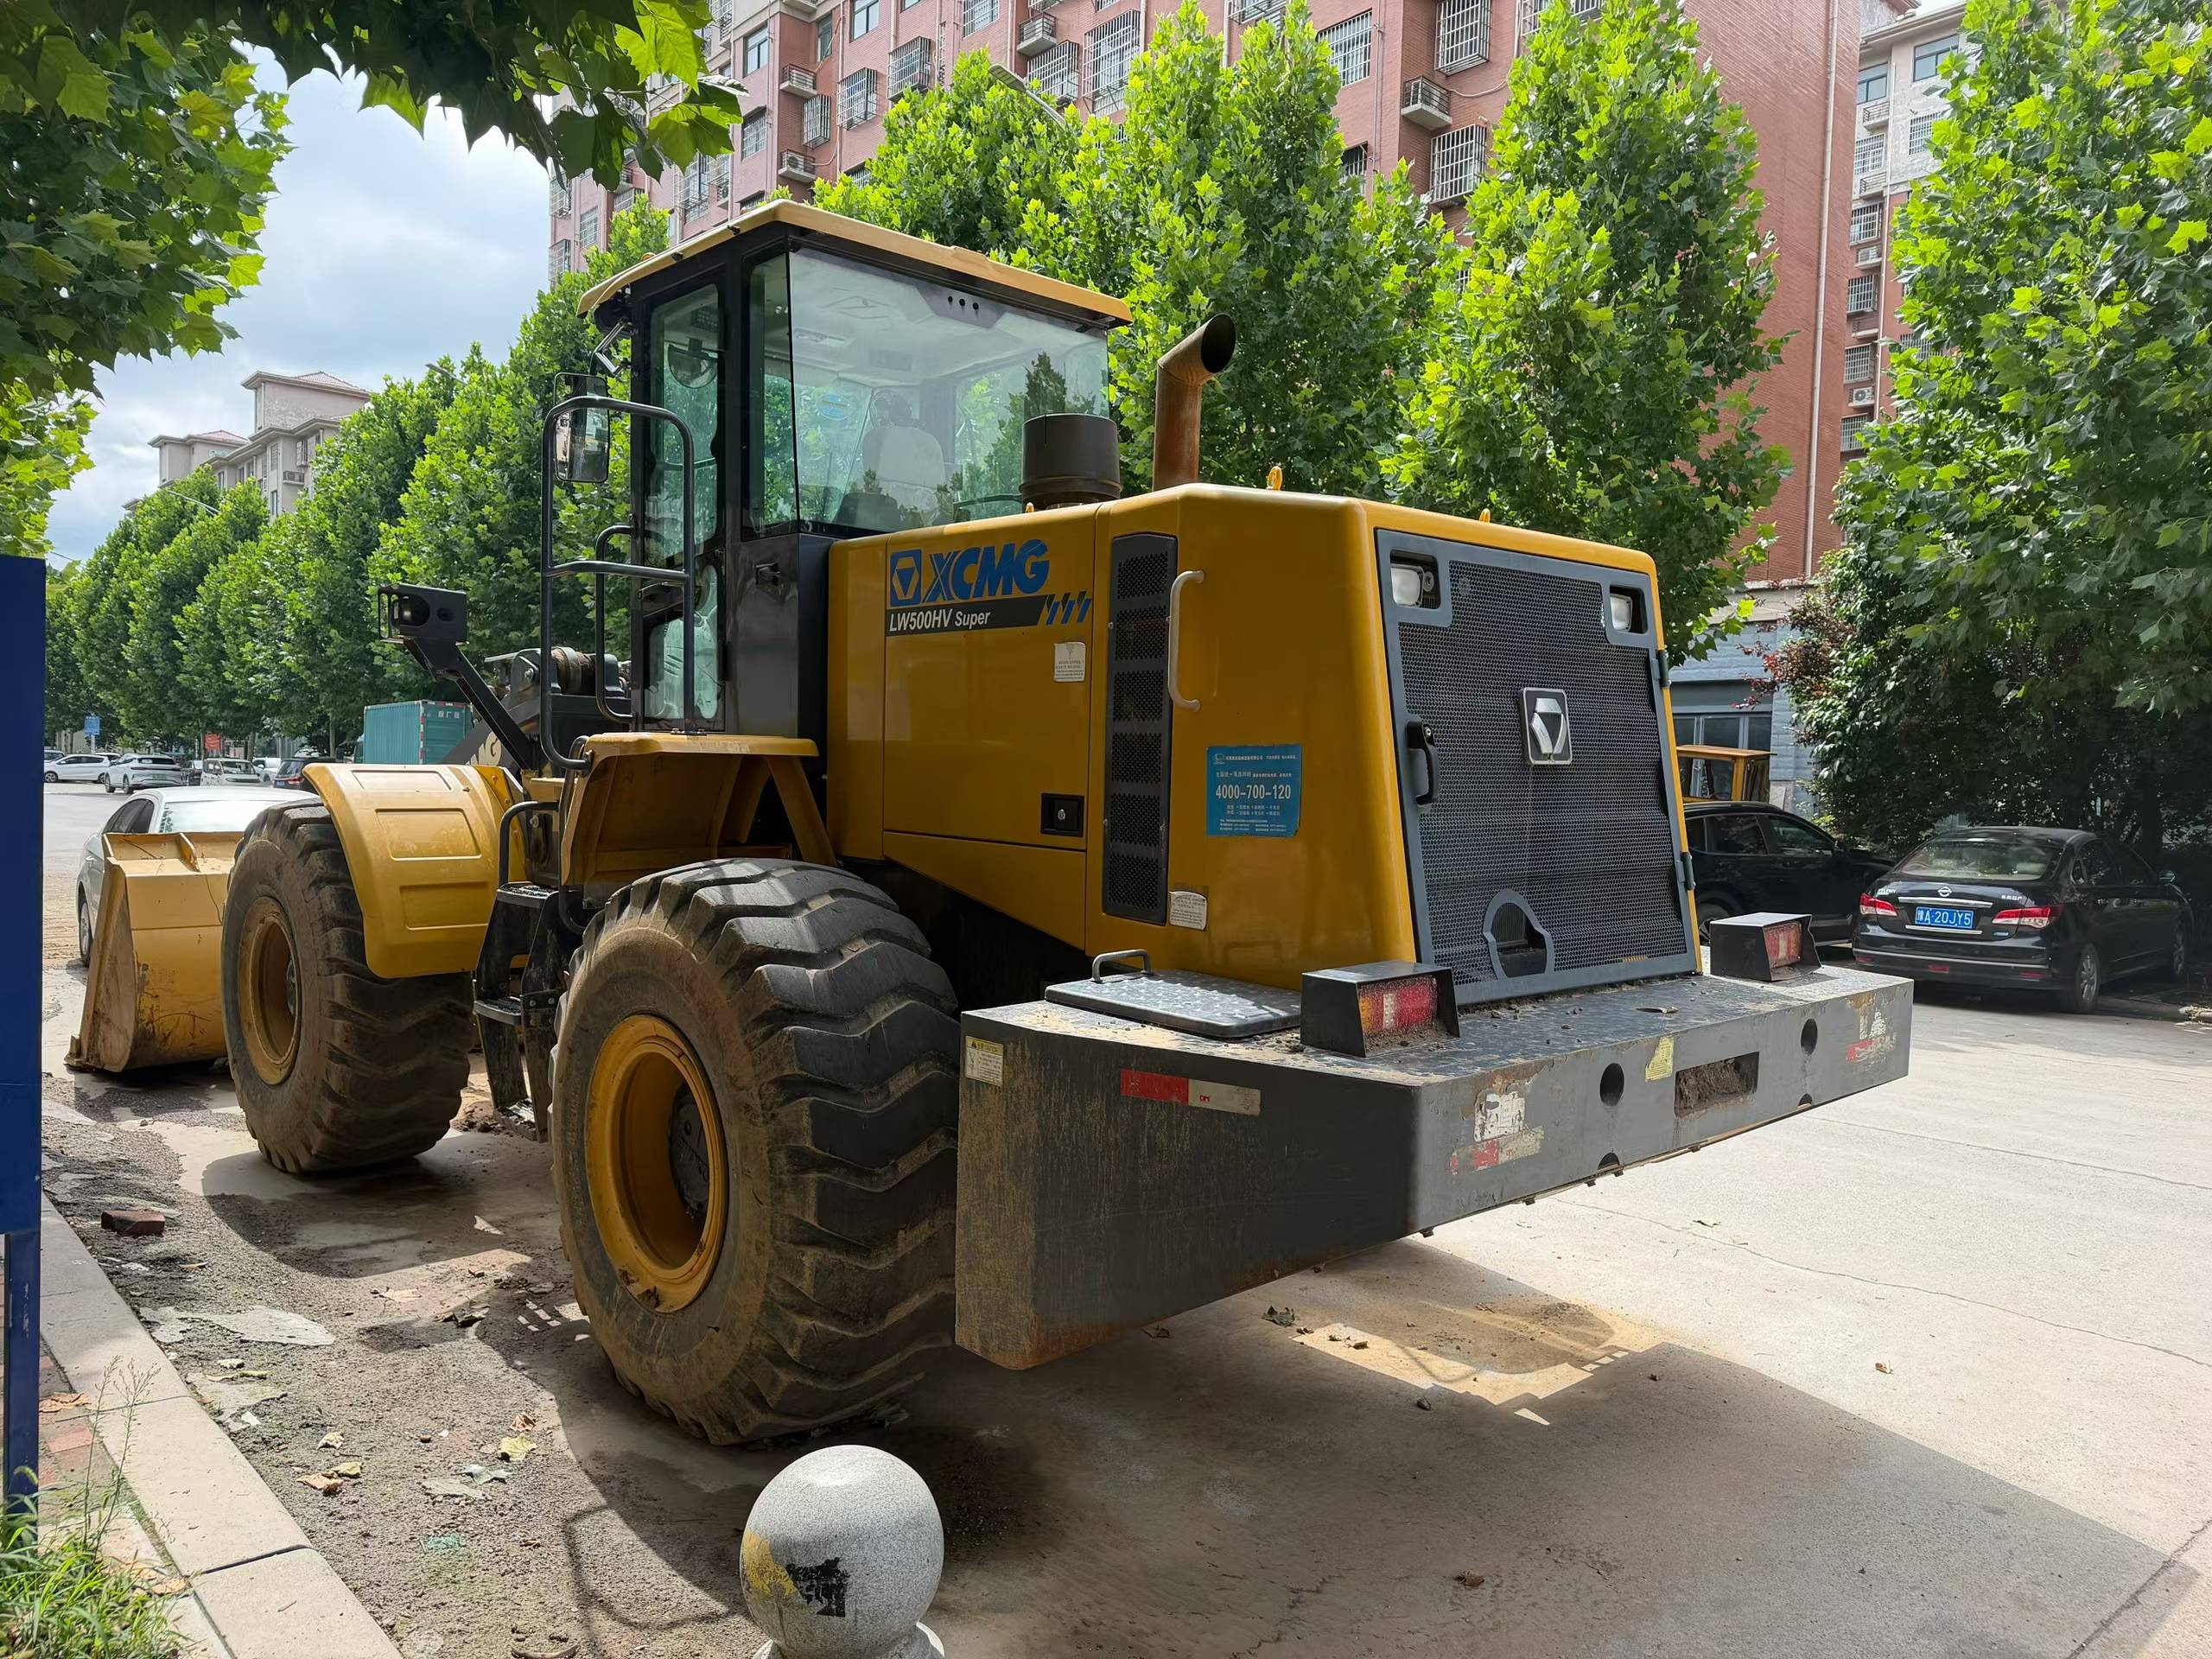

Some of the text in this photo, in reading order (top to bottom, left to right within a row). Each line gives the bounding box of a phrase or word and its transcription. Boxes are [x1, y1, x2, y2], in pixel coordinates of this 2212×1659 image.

[922, 539, 1050, 603] XCMG
[889, 608, 990, 632] LW500HV Super
[1216, 785, 1291, 799] 4000-700-120
